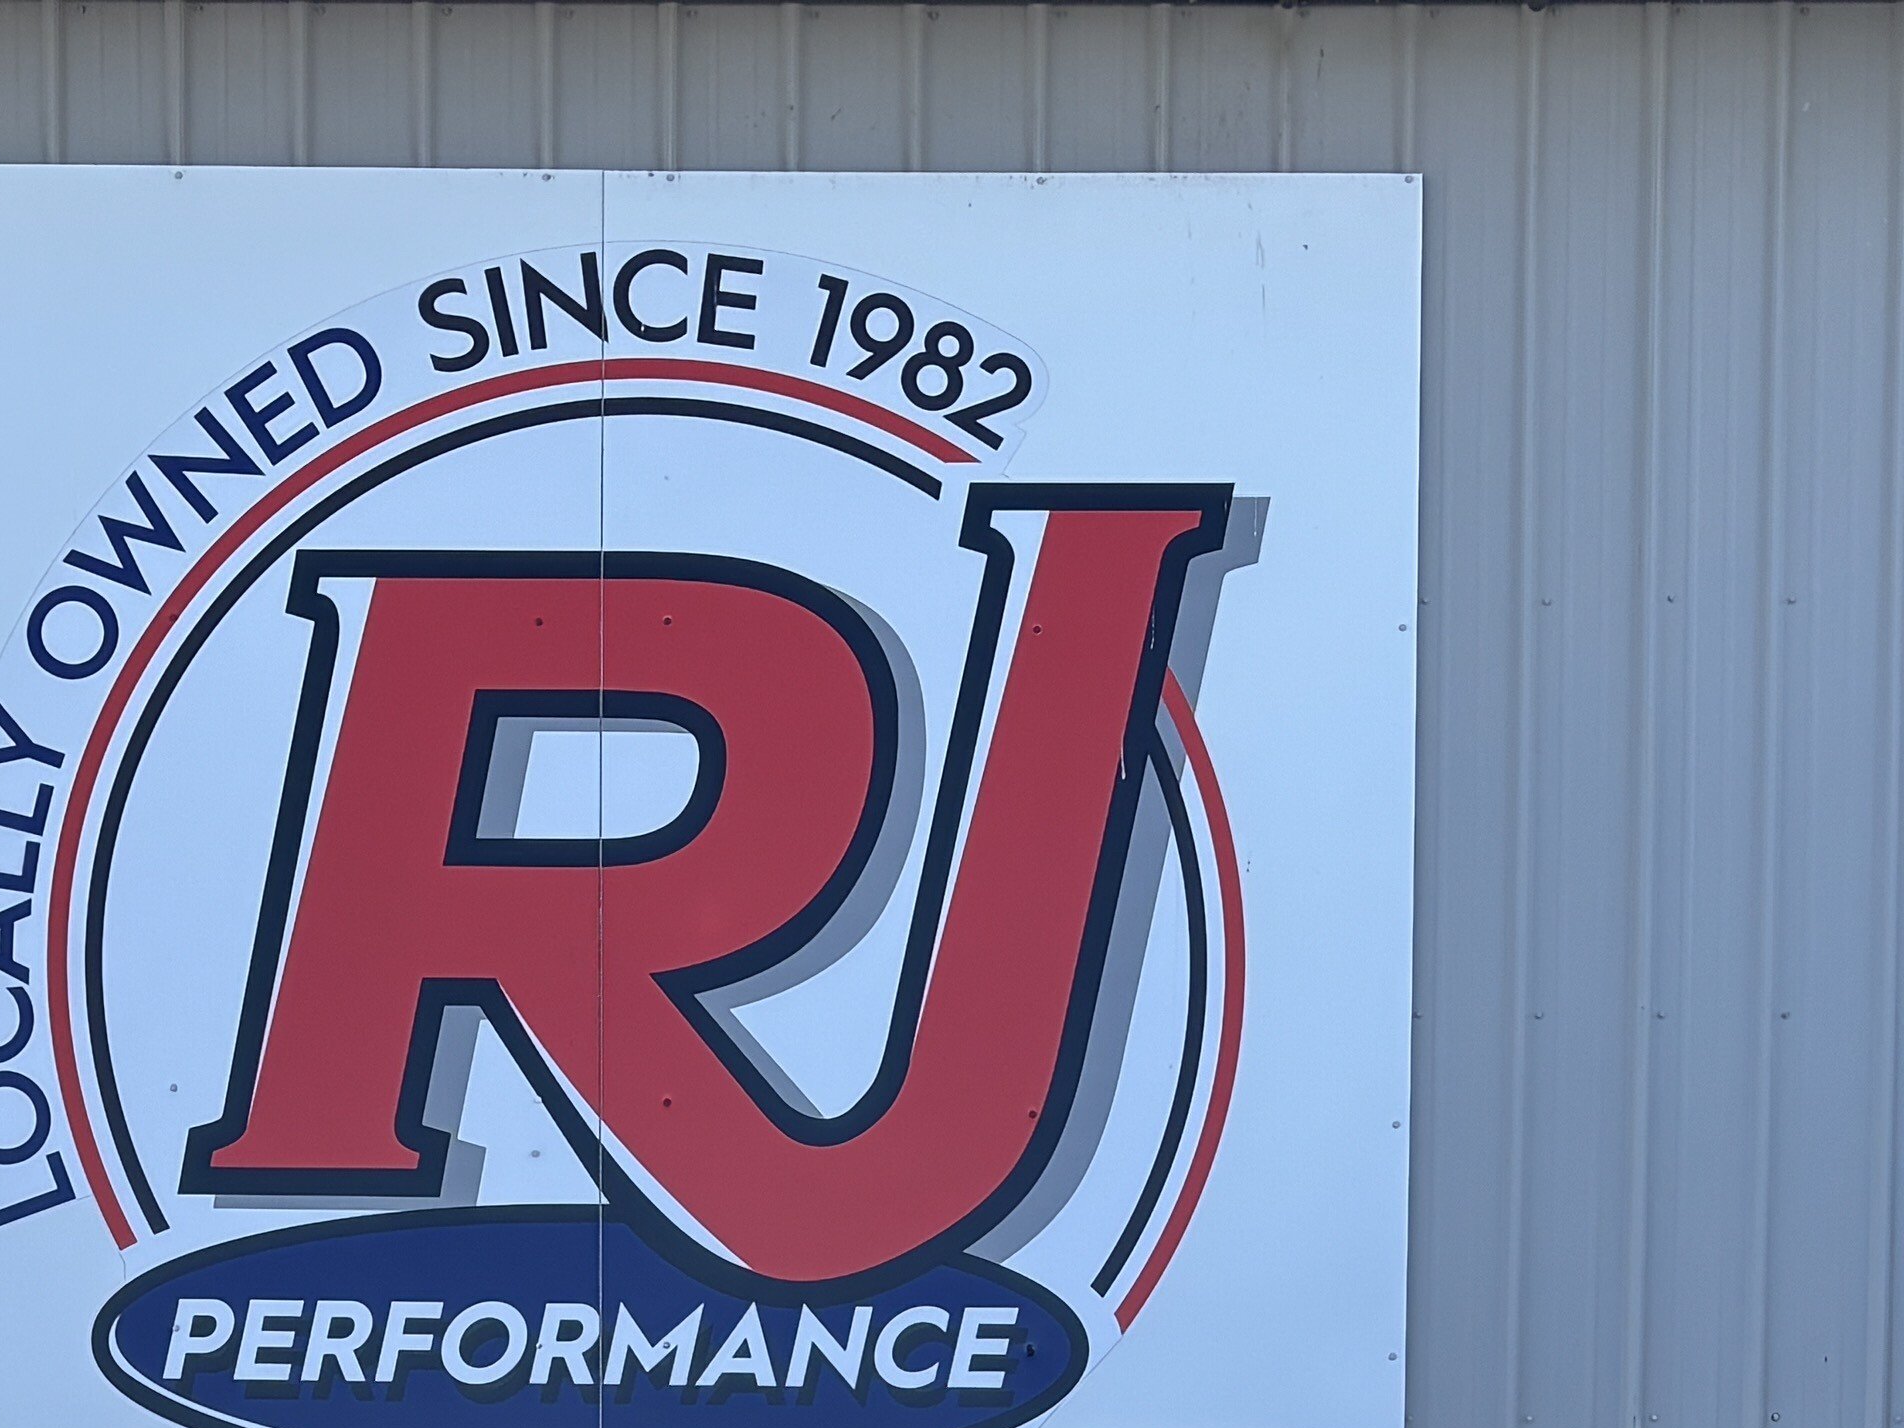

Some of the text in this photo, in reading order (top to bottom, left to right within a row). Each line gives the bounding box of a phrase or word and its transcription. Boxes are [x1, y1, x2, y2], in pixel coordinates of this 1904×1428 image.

[26, 327, 383, 680] OWNED
[417, 248, 764, 373] SINCE
[809, 274, 1033, 450] 1982
[178, 482, 1234, 1305] RJ
[162, 1298, 1019, 1389] PERFORMANCE
